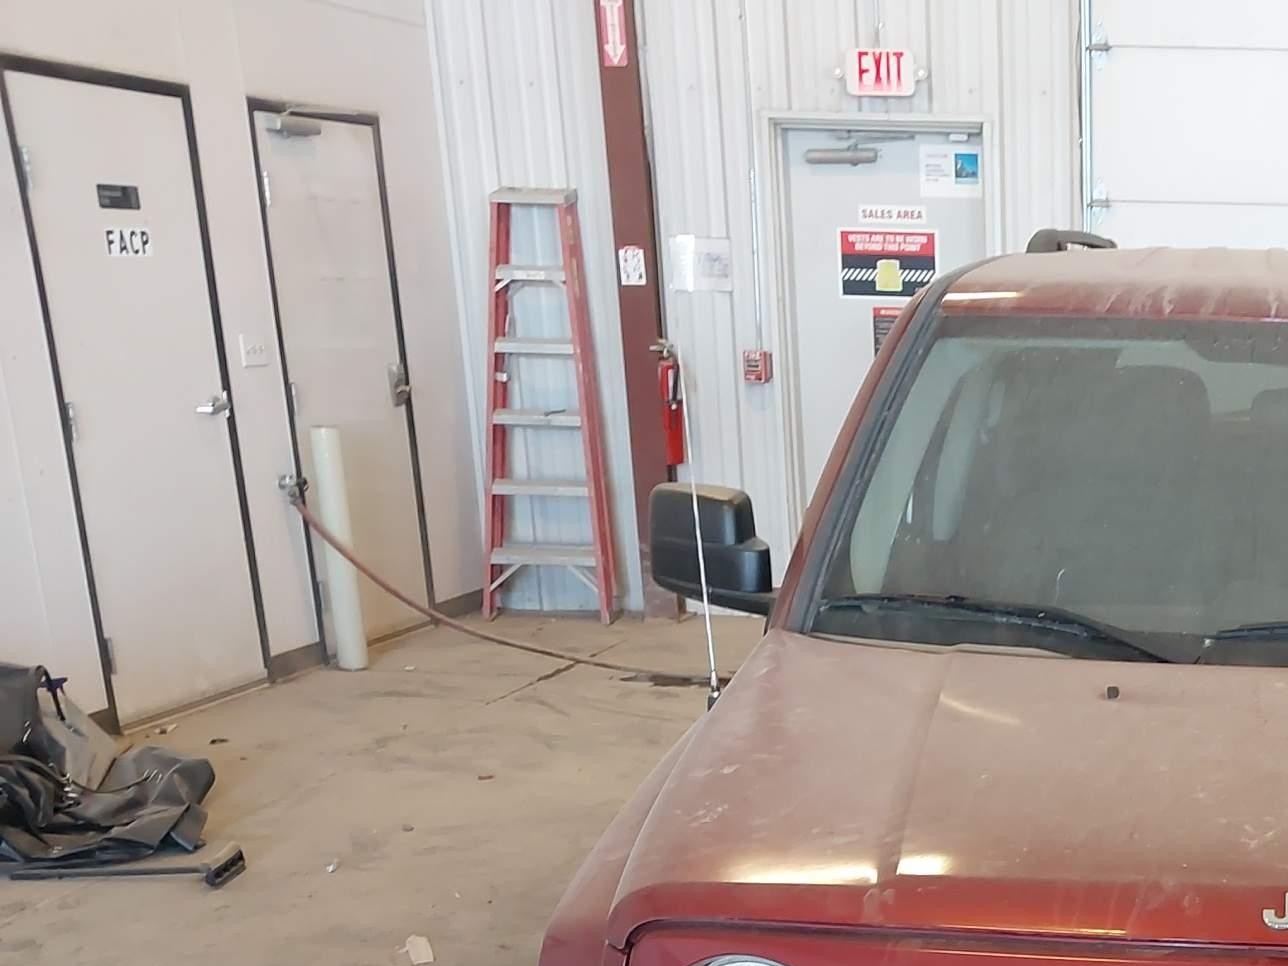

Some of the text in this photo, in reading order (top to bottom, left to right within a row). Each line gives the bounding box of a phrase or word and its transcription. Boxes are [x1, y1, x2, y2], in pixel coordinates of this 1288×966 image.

[857, 51, 904, 90] EXIT
[861, 209, 923, 220] SALES AREA
[105, 229, 149, 255] FACP
